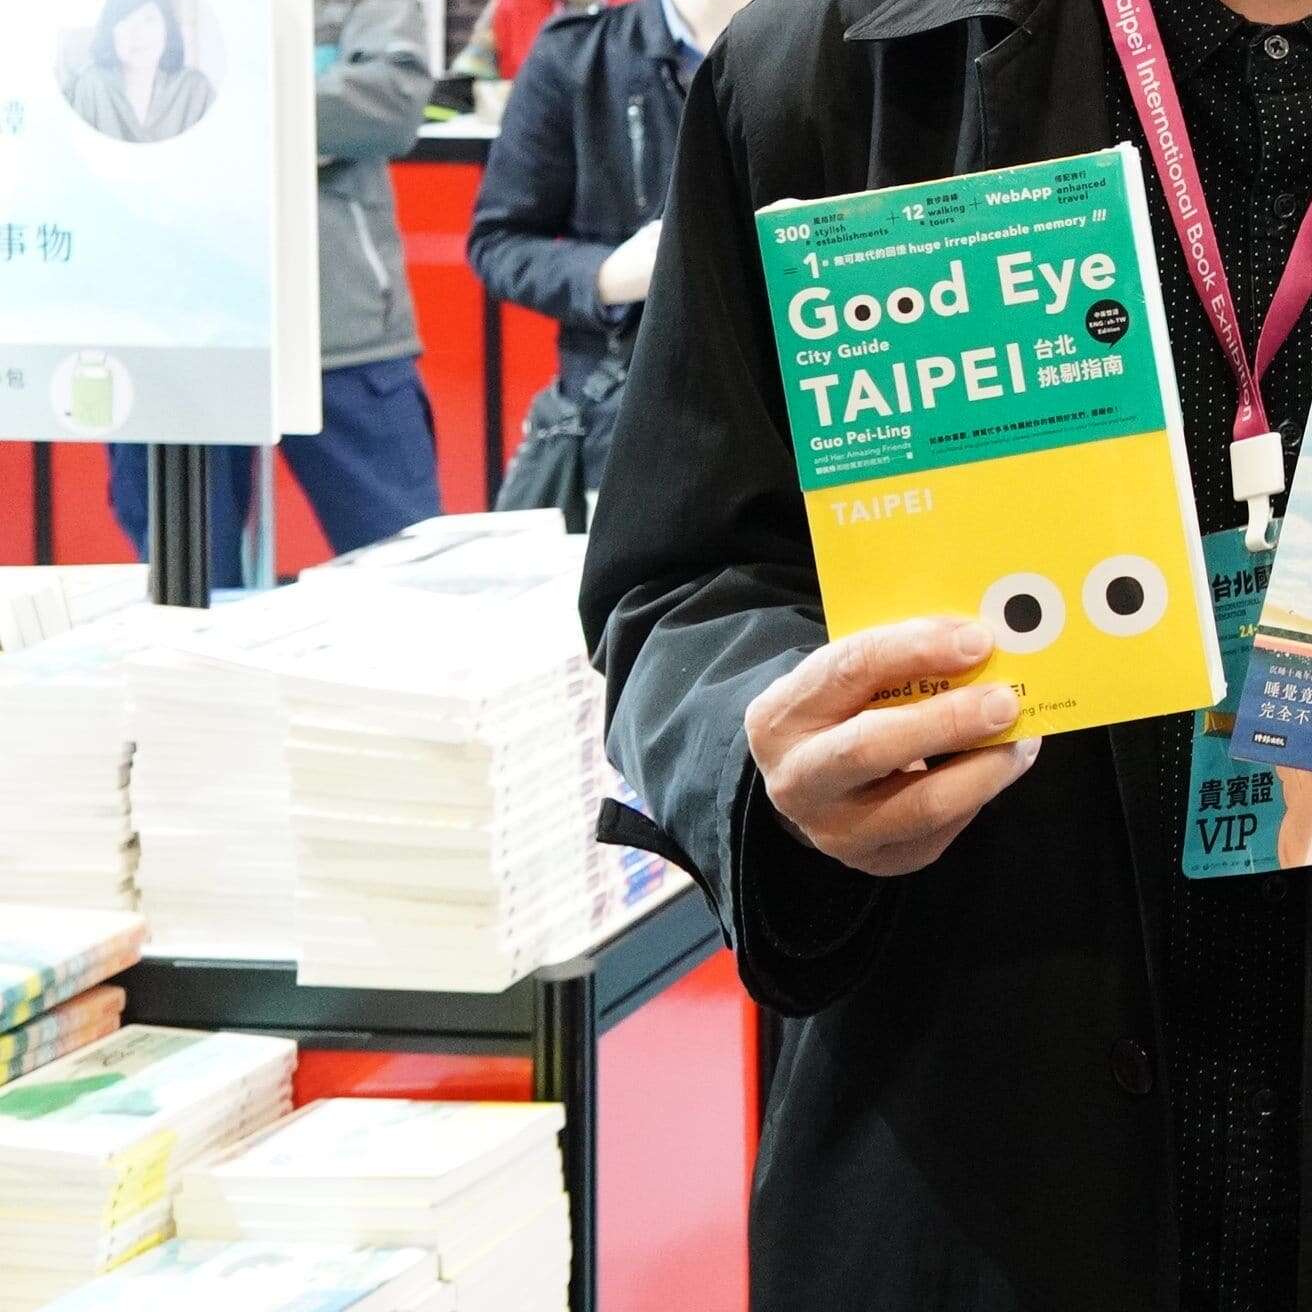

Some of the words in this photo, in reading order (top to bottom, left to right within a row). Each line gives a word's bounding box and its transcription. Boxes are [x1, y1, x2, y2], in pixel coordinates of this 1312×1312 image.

[985, 186, 1052, 206] WebApp
[1056, 178, 1107, 194] enhanced
[1057, 192, 1089, 205] travel
[902, 204, 925, 221] 12
[928, 204, 966, 217] walking
[929, 217, 955, 228] tours
[774, 224, 810, 244] 300
[803, 253, 820, 279] 1
[909, 240, 941, 256] huge
[944, 223, 1029, 248] irreplaceable
[1033, 215, 1087, 235] memory
[1135, 57, 1191, 220] International
[1187, 219, 1216, 292] Book
[1211, 294, 1252, 422] Exhibition
[788, 259, 970, 341] Good
[996, 252, 1117, 315] Eye
[796, 349, 832, 366] City
[838, 339, 890, 359] Guide
[1033, 335, 1077, 361] 台北
[799, 343, 1026, 427] TAIPEI
[1037, 355, 1124, 389] 挑剔指南
[810, 436, 843, 451] Guo
[846, 425, 911, 445] Pei-Ling
[832, 488, 934, 526] TAIPEI
[919, 678, 950, 696] Eye
[1039, 698, 1077, 711] Friends
[1198, 771, 1274, 812] 貴賓證
[1196, 813, 1258, 855] VIP
